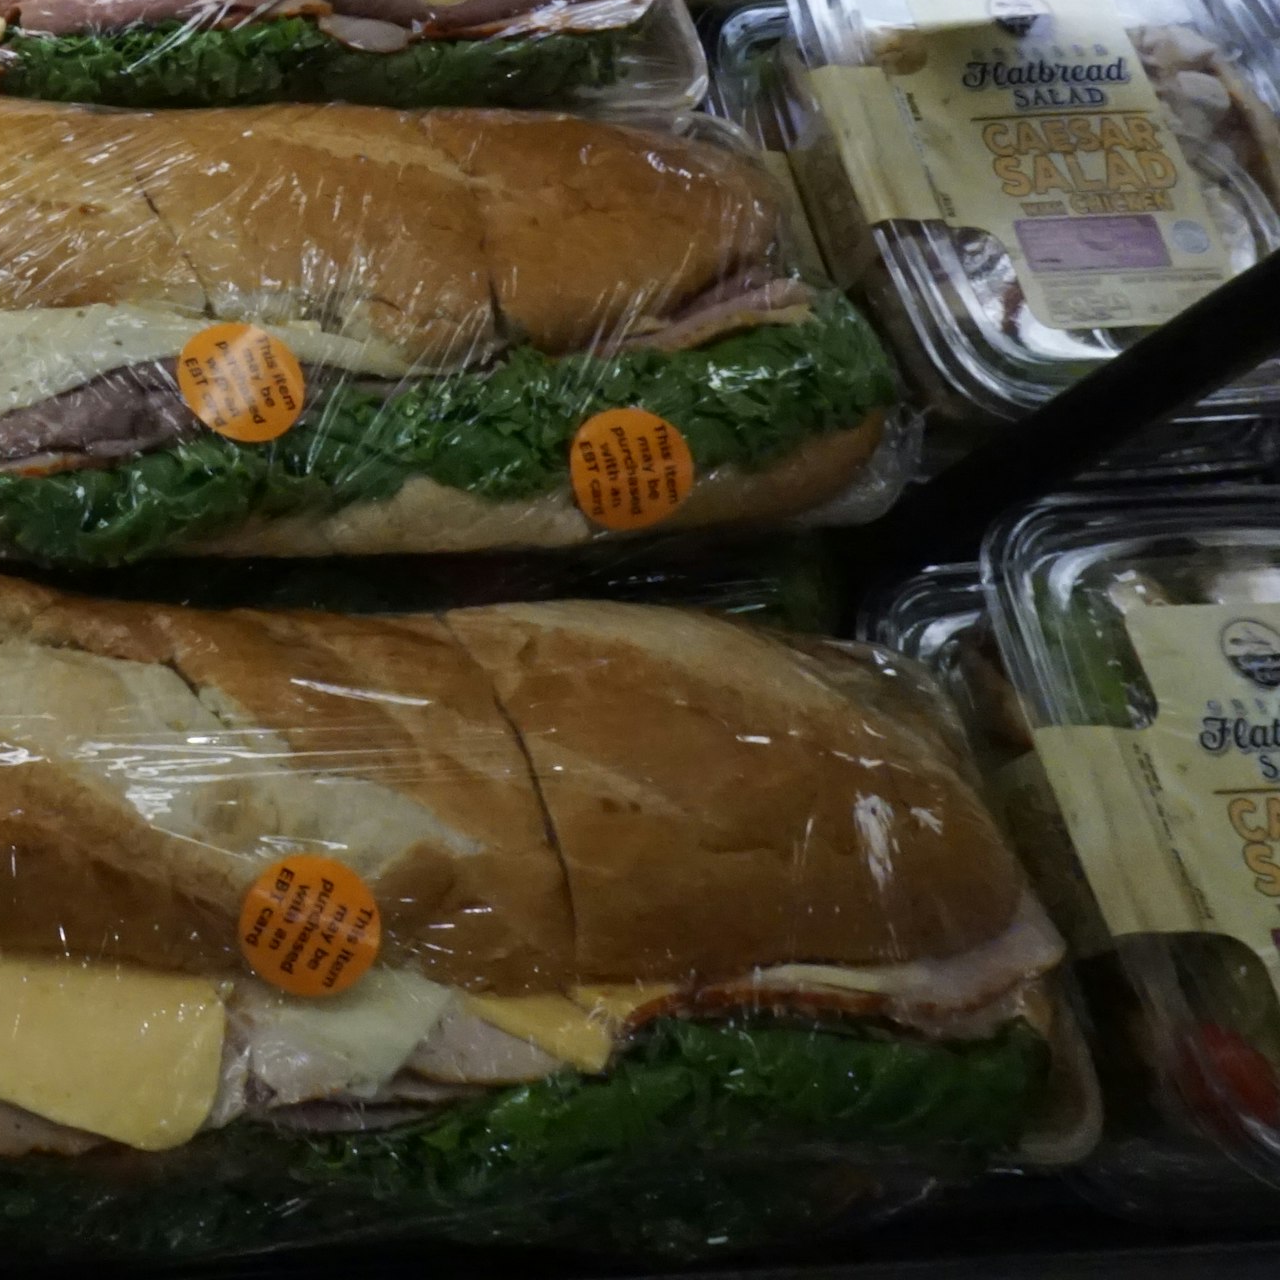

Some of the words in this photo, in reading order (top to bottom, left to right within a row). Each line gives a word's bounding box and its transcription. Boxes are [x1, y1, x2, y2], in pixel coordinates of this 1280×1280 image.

[962, 57, 1130, 91] Flatbread
[1014, 87, 1108, 110] SALAD
[982, 117, 1162, 157] CAESAR
[993, 151, 1176, 197] SALAD
[1069, 191, 1174, 214] CHICKEN
[185, 357, 208, 386] EBT
[261, 386, 275, 407] be
[272, 374, 296, 411] item
[579, 441, 600, 473] EBT
[590, 479, 605, 516] card
[600, 442, 618, 481] with
[610, 487, 621, 508] an
[610, 426, 641, 515] purchased
[638, 436, 655, 472] may
[648, 478, 660, 500] be
[654, 424, 672, 459] This
[665, 465, 678, 504] item
[283, 884, 310, 924] with
[245, 907, 274, 947] card
[268, 928, 287, 950] an
[279, 878, 334, 975] purchased
[321, 906, 348, 944] may
[347, 907, 374, 945] This
[307, 948, 330, 970] be
[322, 949, 354, 988] item
